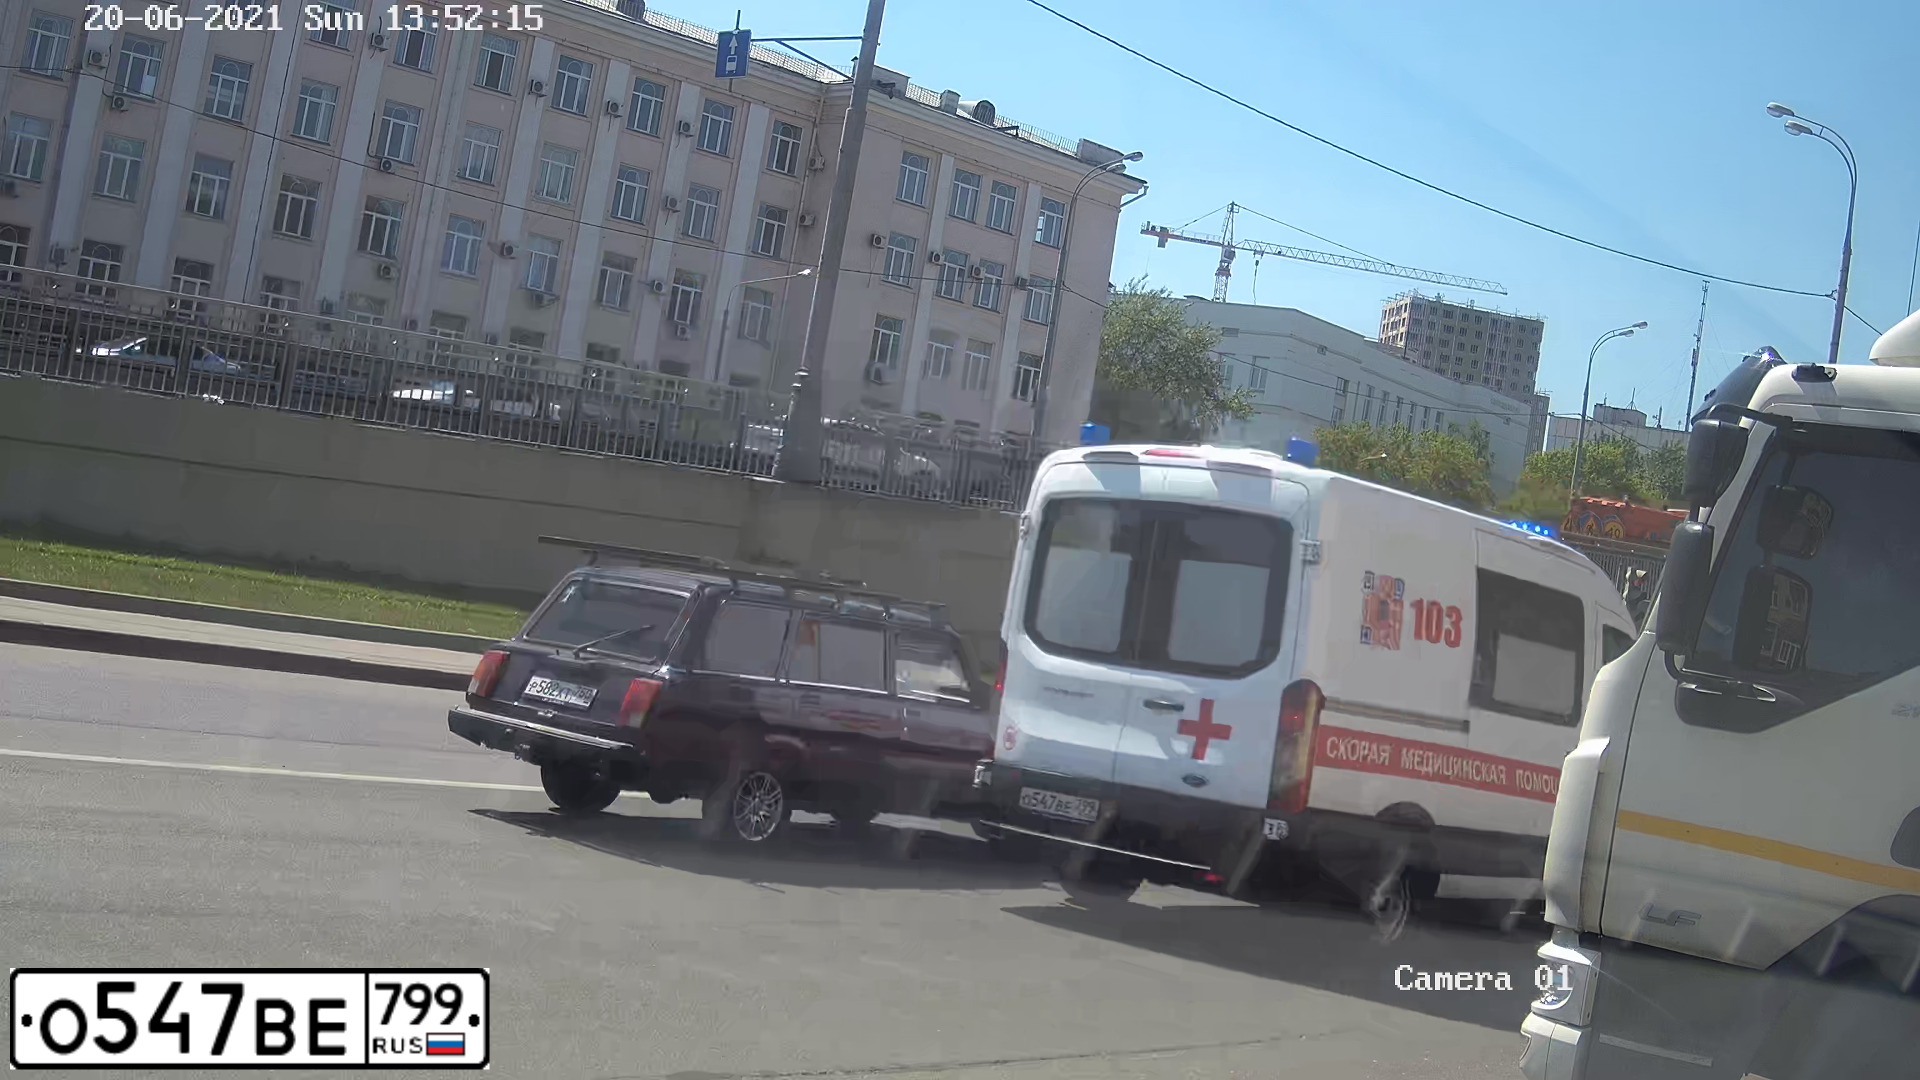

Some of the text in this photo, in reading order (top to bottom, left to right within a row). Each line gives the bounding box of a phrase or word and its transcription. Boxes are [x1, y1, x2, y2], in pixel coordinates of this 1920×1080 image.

[1409, 598, 1463, 649] 103
[1326, 736, 1392, 766] СКОРАЯ
[1400, 747, 1507, 785] МЕДИЦИНСКАЯ
